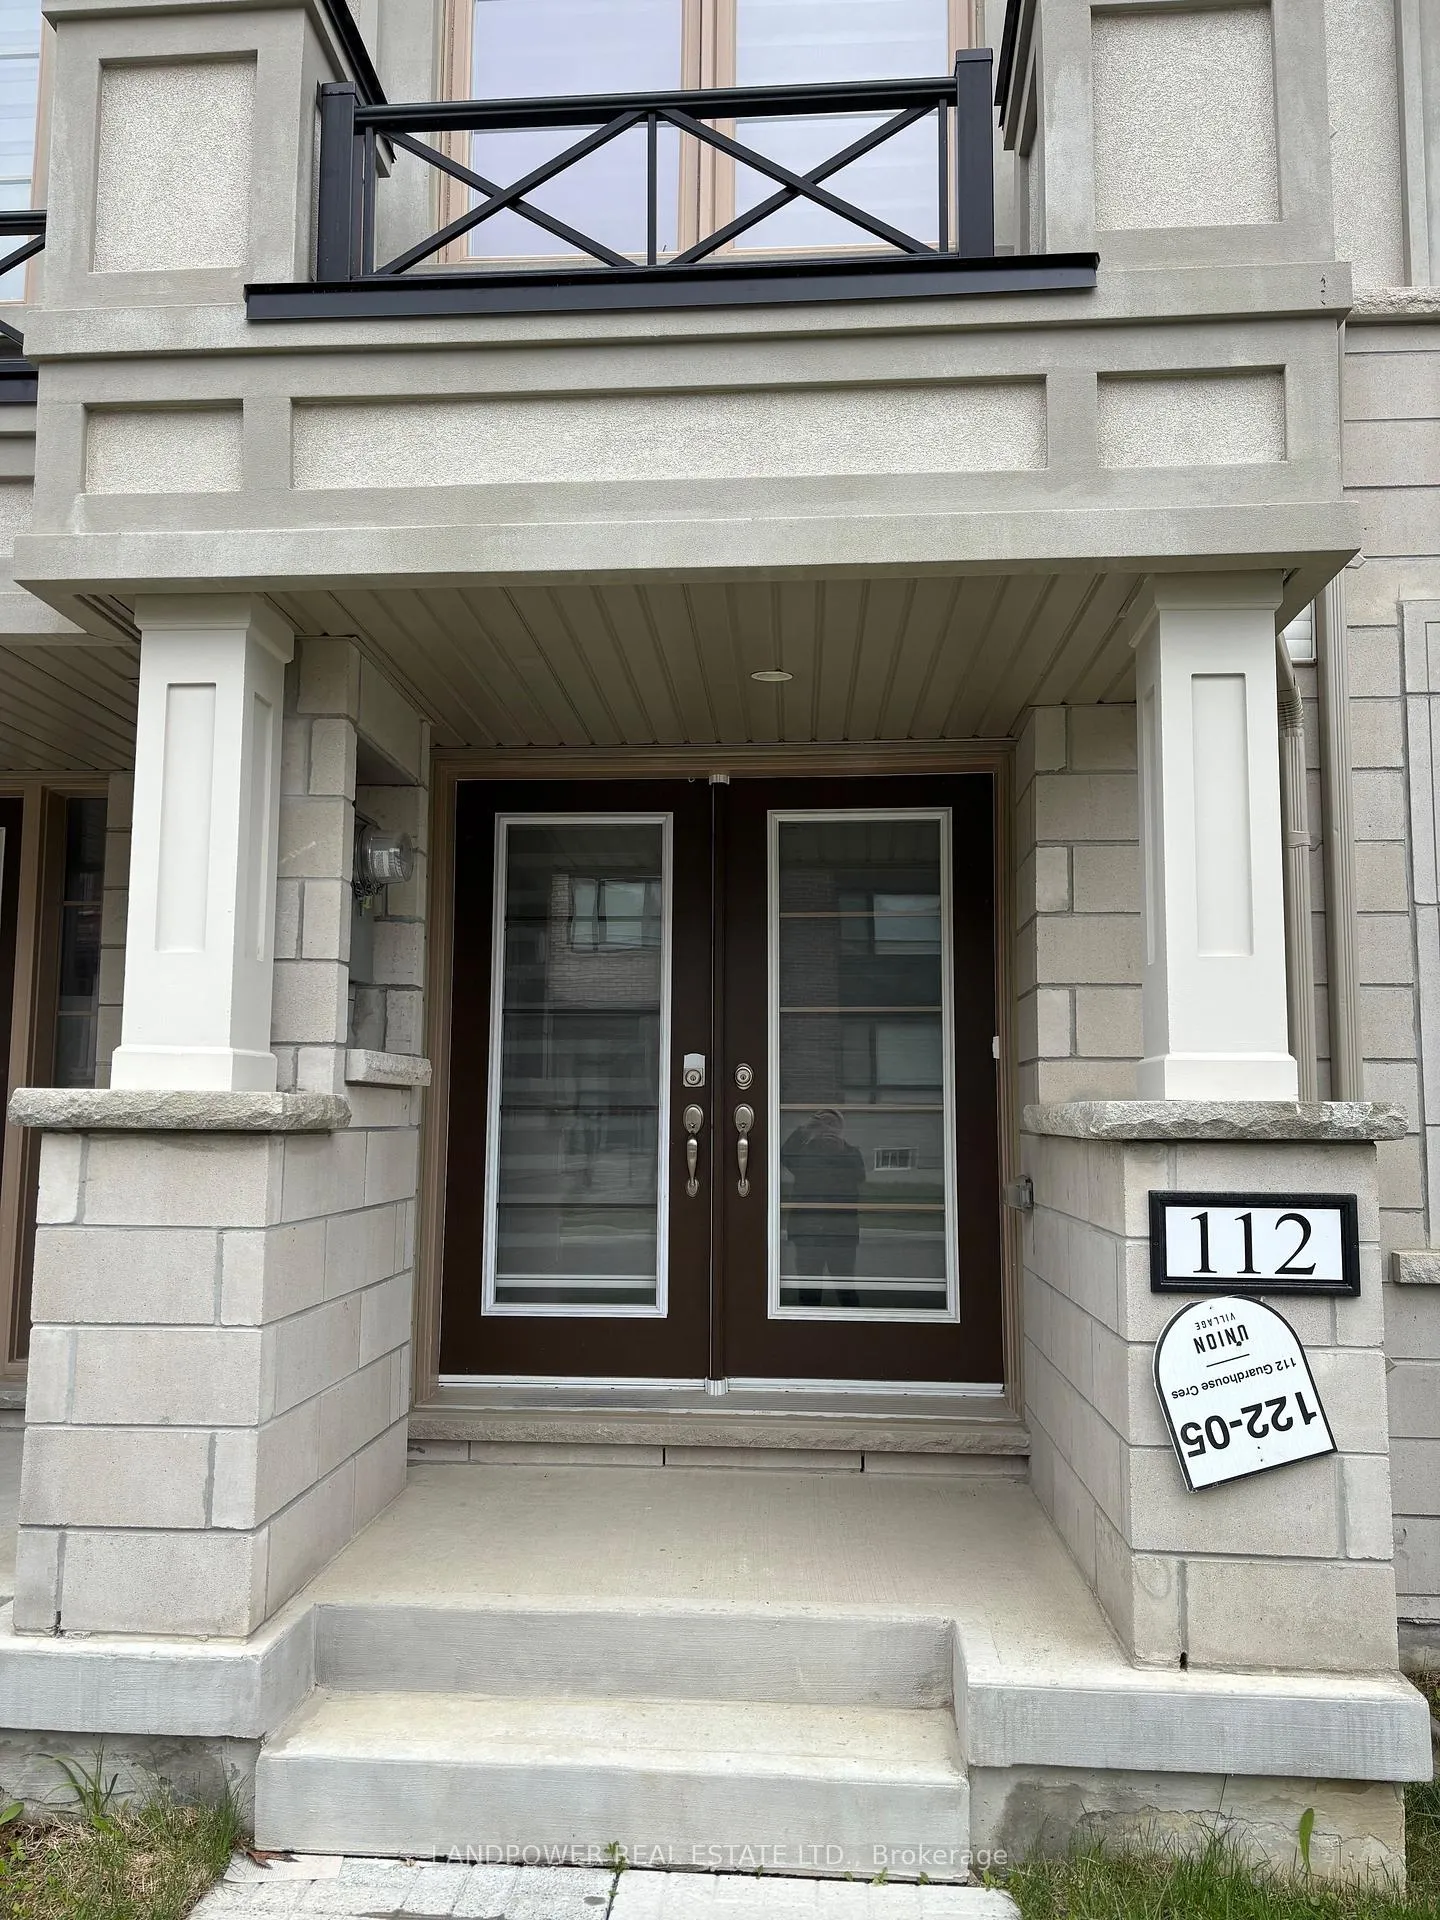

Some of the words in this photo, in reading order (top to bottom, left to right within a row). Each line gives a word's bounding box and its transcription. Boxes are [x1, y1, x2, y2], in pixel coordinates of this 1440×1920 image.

[1190, 1211, 1317, 1275] 112
[1194, 1312, 1236, 1331] VILLAGE
[1193, 1324, 1249, 1354] UNION
[1201, 1363, 1273, 1391] Guardhouse
[1275, 1357, 1297, 1371] 112
[1171, 1385, 1199, 1399] Cres
[1180, 1391, 1317, 1458] 122-05
